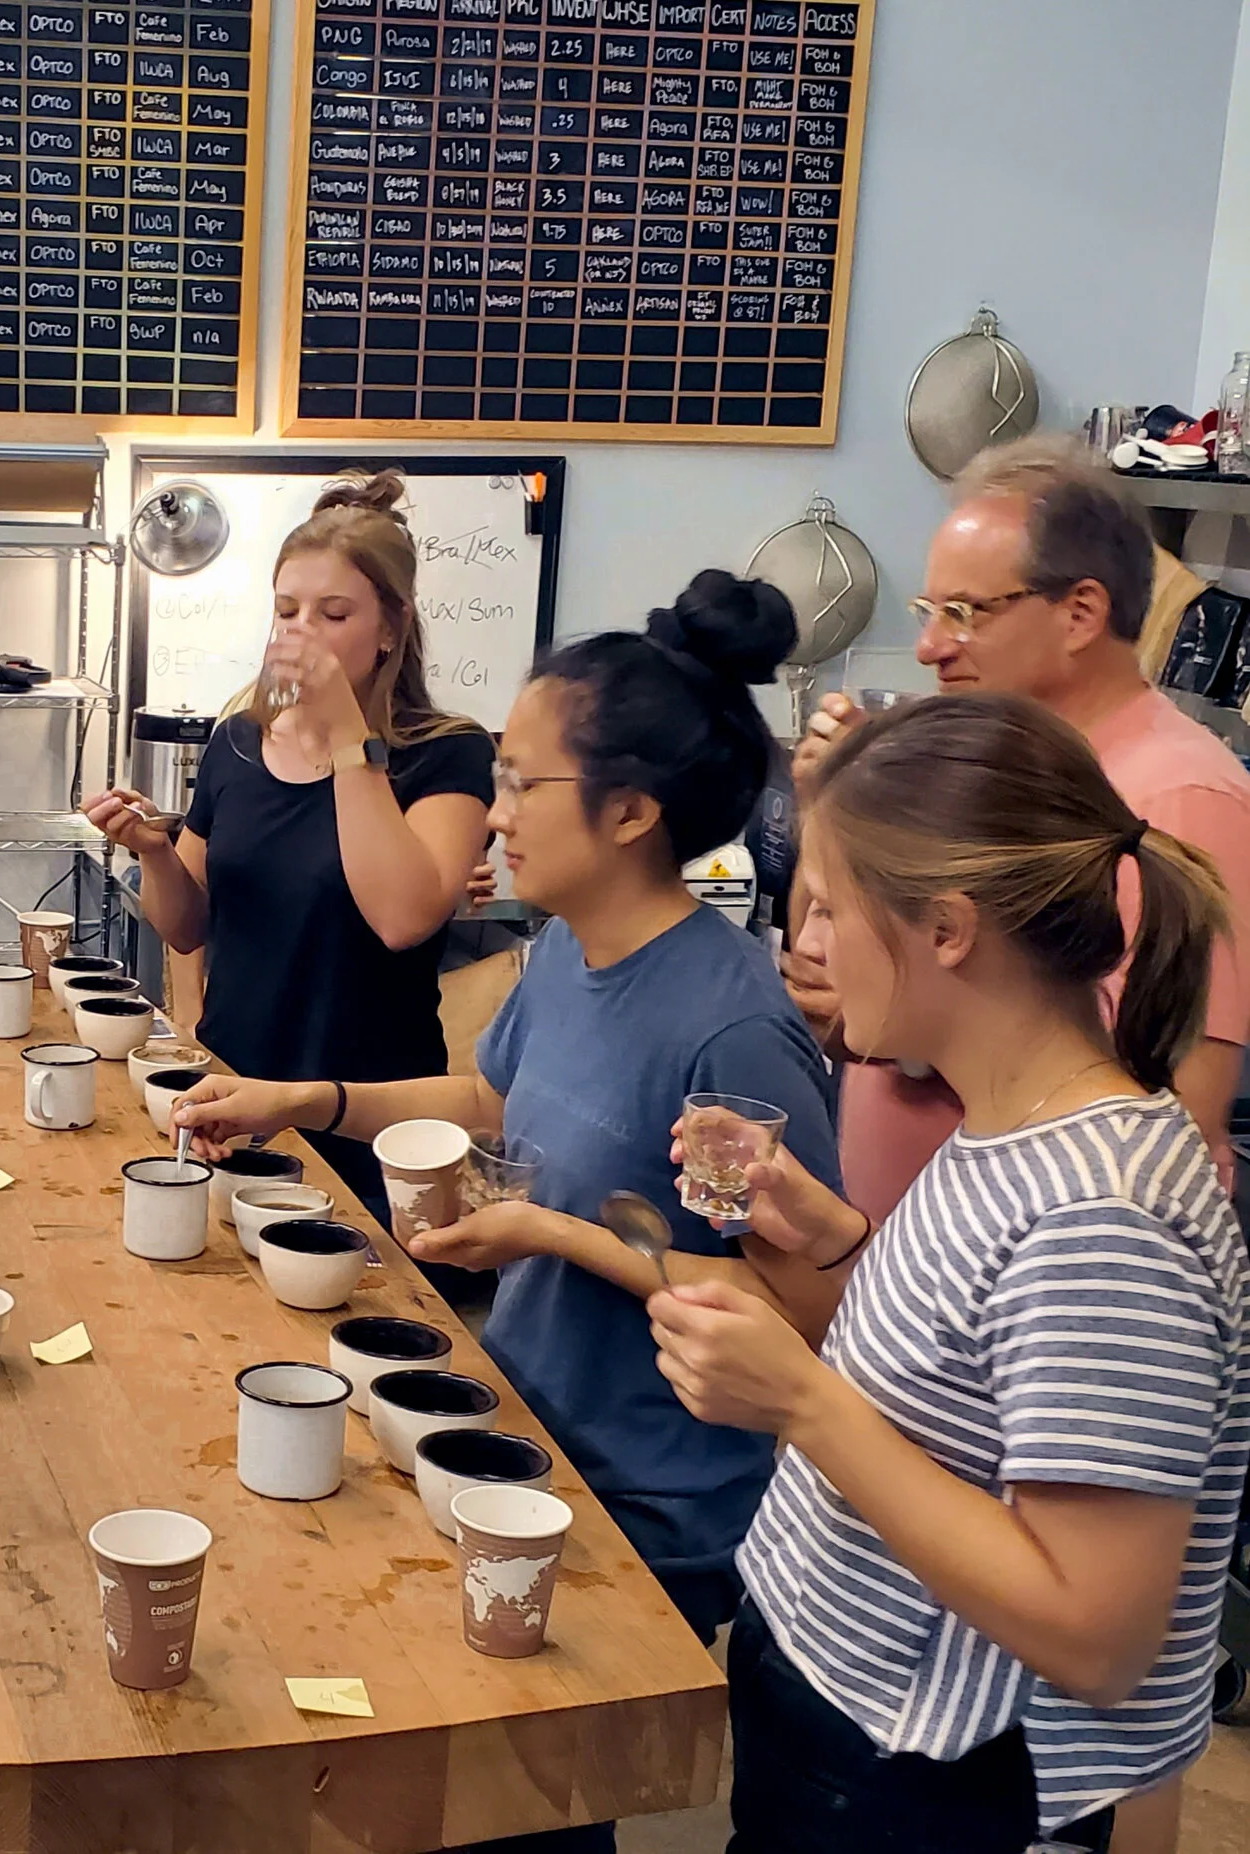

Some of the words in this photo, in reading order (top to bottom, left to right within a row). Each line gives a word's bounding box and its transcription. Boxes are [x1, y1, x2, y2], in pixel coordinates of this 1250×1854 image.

[94, 12, 125, 26] FTO
[138, 13, 167, 27] Cafe
[602, 1, 650, 26] WHSE
[659, 5, 706, 25] IMPORT
[29, 15, 75, 33] OPTCO
[754, 12, 797, 32] NOTES
[805, 11, 855, 34] ACCESS
[196, 24, 230, 42] Feb
[321, 26, 363, 46] PNG
[385, 29, 430, 48] Purosa
[550, 40, 583, 57] 2.25
[606, 42, 636, 59] HERE
[712, 41, 737, 53] FTO
[805, 47, 830, 60] FOH
[30, 55, 74, 75] OPTCO
[94, 52, 122, 67] FTO
[750, 51, 771, 66] USE
[775, 49, 795, 70] ME!
[814, 61, 840, 73] BOH
[196, 66, 230, 88] Aug
[316, 65, 367, 87] Congo
[558, 77, 568, 99] 4
[603, 78, 632, 94] HERE
[652, 78, 692, 93] Mighty
[801, 84, 827, 97] FOH
[31, 94, 72, 110] OPTCO
[94, 91, 122, 105] FTO
[140, 92, 169, 107] Cafe
[810, 98, 835, 110] BOH
[192, 104, 232, 125] May
[552, 114, 575, 128] .25
[601, 115, 630, 131] HERE
[650, 119, 688, 137] Agora
[796, 119, 821, 133] FOH
[93, 128, 122, 142] FTO
[743, 123, 762, 139] USE
[765, 120, 786, 143] ME!
[30, 131, 73, 150] OPTCO
[809, 133, 835, 146] BOH
[194, 142, 230, 156] Mar
[705, 150, 730, 163] FTO
[598, 152, 625, 167] HERE
[795, 153, 820, 167] FOH
[92, 166, 120, 180] FTO
[137, 167, 163, 180] Cafe
[741, 160, 760, 175] USE
[805, 168, 830, 182] BOH
[30, 168, 72, 187] OPTCO
[189, 182, 227, 202] May
[542, 188, 566, 207] 3.5
[594, 189, 625, 204] HERE
[702, 186, 724, 199] FTO
[792, 192, 817, 205] FOH
[32, 207, 72, 228] Agora
[92, 205, 118, 220] FTO
[798, 205, 824, 217] BOH
[194, 214, 225, 232] Apr
[700, 221, 722, 234] FTO
[592, 225, 624, 242] HERE
[643, 226, 683, 242] OPTCO
[788, 225, 814, 239] FOH
[30, 245, 75, 262] OPTCO
[91, 240, 117, 254] FTO
[134, 242, 162, 255] Cafe
[796, 240, 821, 252] BOH
[191, 250, 225, 269] Oct
[697, 255, 720, 267] FTO
[785, 260, 813, 272] FOH
[545, 258, 556, 277] 5
[91, 278, 117, 291] FTO
[134, 279, 162, 291] Cafe
[795, 274, 821, 287] BOH
[29, 282, 75, 299] OPTCO
[191, 287, 223, 304] Feb
[28, 321, 72, 338] OPTCO
[90, 316, 116, 330] FTO
[193, 329, 220, 345] n/a
[468, 597, 514, 622] Sum
